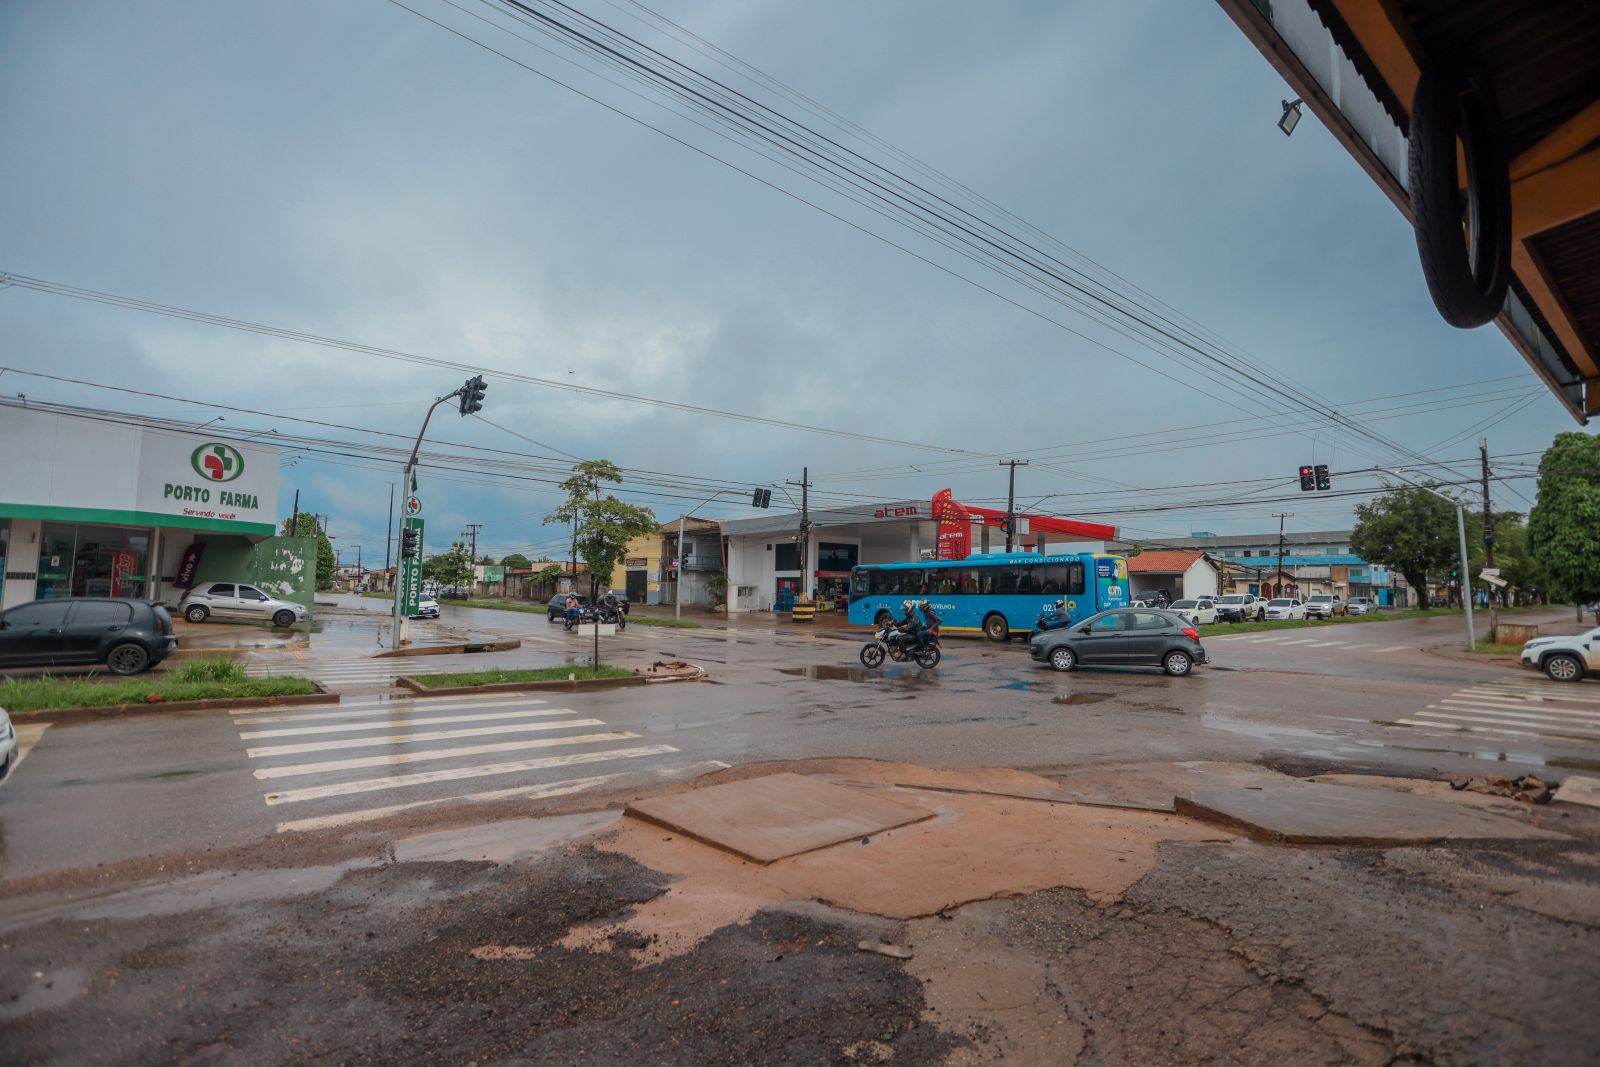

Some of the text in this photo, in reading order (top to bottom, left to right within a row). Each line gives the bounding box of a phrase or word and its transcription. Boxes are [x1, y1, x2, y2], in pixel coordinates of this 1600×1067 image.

[164, 483, 259, 510] PORTO FARMA
[182, 507, 215, 518] Servindo
[874, 505, 918, 518] atem
[1024, 556, 1080, 564] CONDICIONADO
[180, 562, 193, 583] vivo
[409, 567, 419, 607] PORTO
